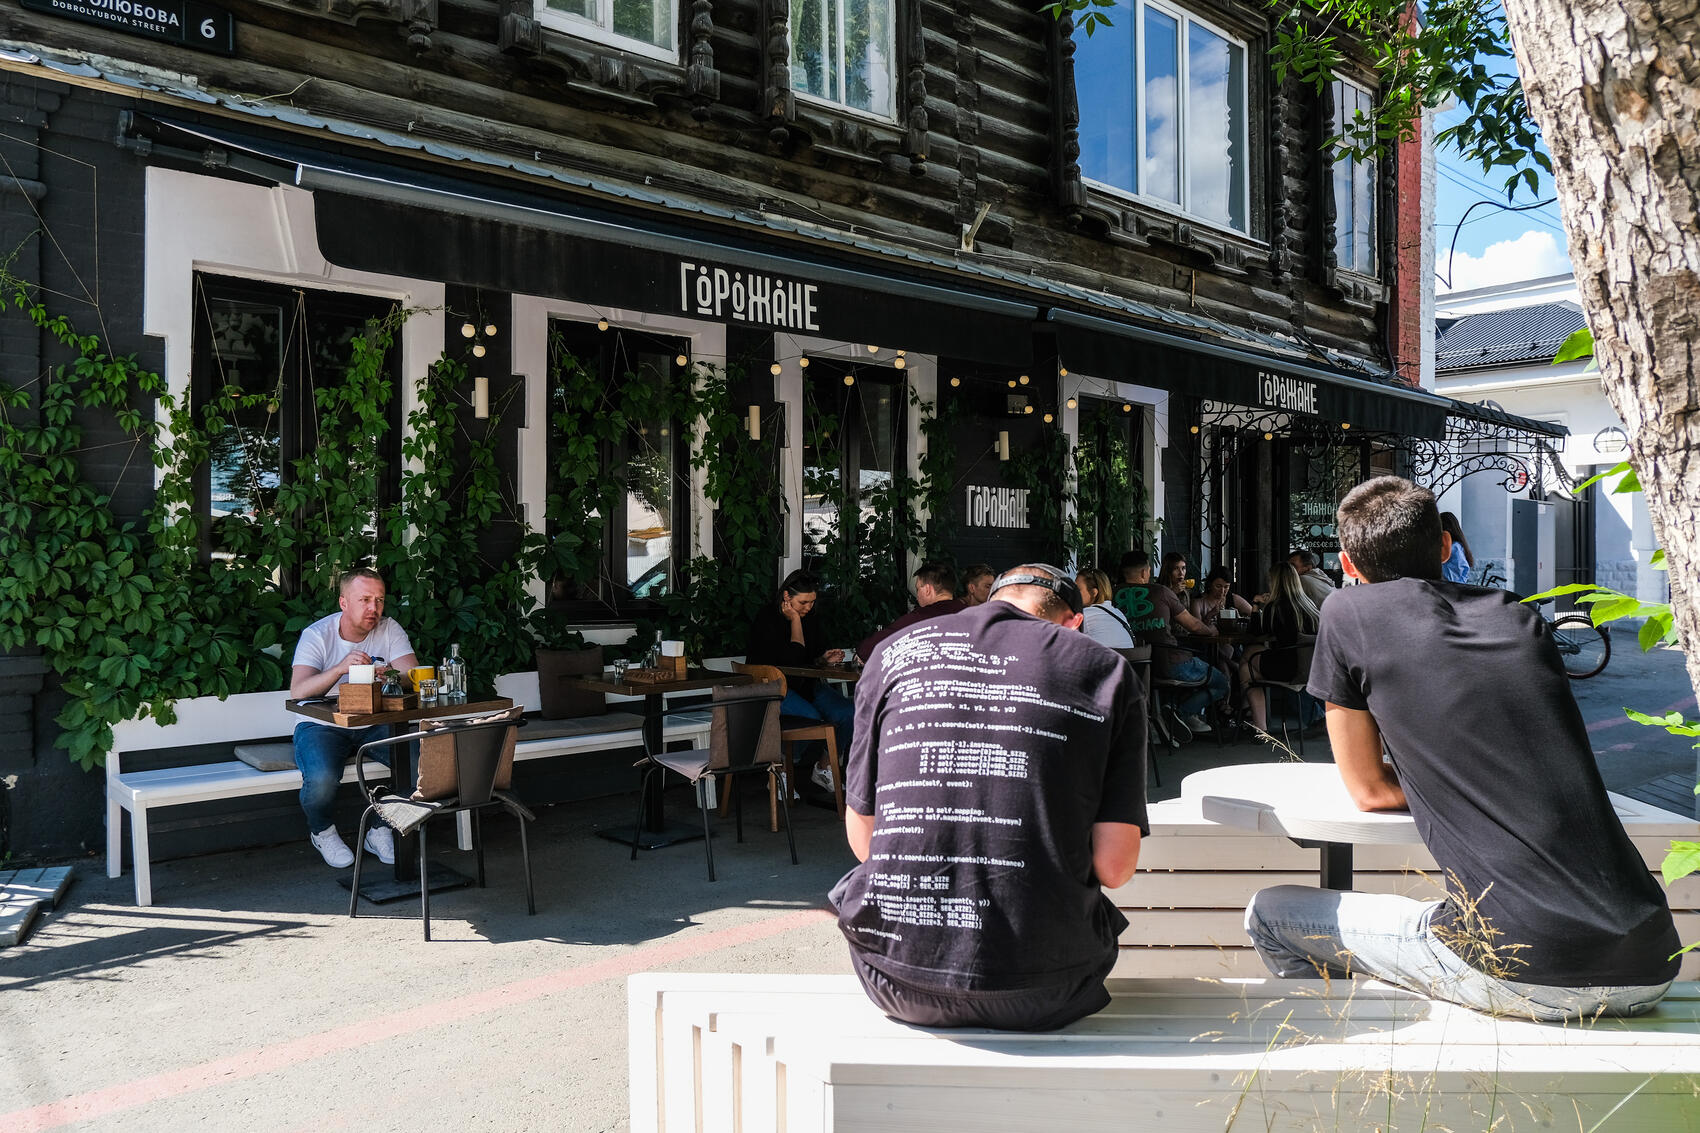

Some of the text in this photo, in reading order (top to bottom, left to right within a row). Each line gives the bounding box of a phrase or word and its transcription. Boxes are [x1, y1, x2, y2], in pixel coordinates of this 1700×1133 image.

[52, 1, 167, 33] DOBROLYUBOVA STREET
[78, 0, 180, 27] ОЛЮБОВА
[200, 18, 216, 39] 6
[680, 261, 820, 331] ГОРОЖАНЕ
[1258, 371, 1319, 415] ГОРОЖАНЕ
[966, 484, 1031, 529] ГОРОЖАНЕ
